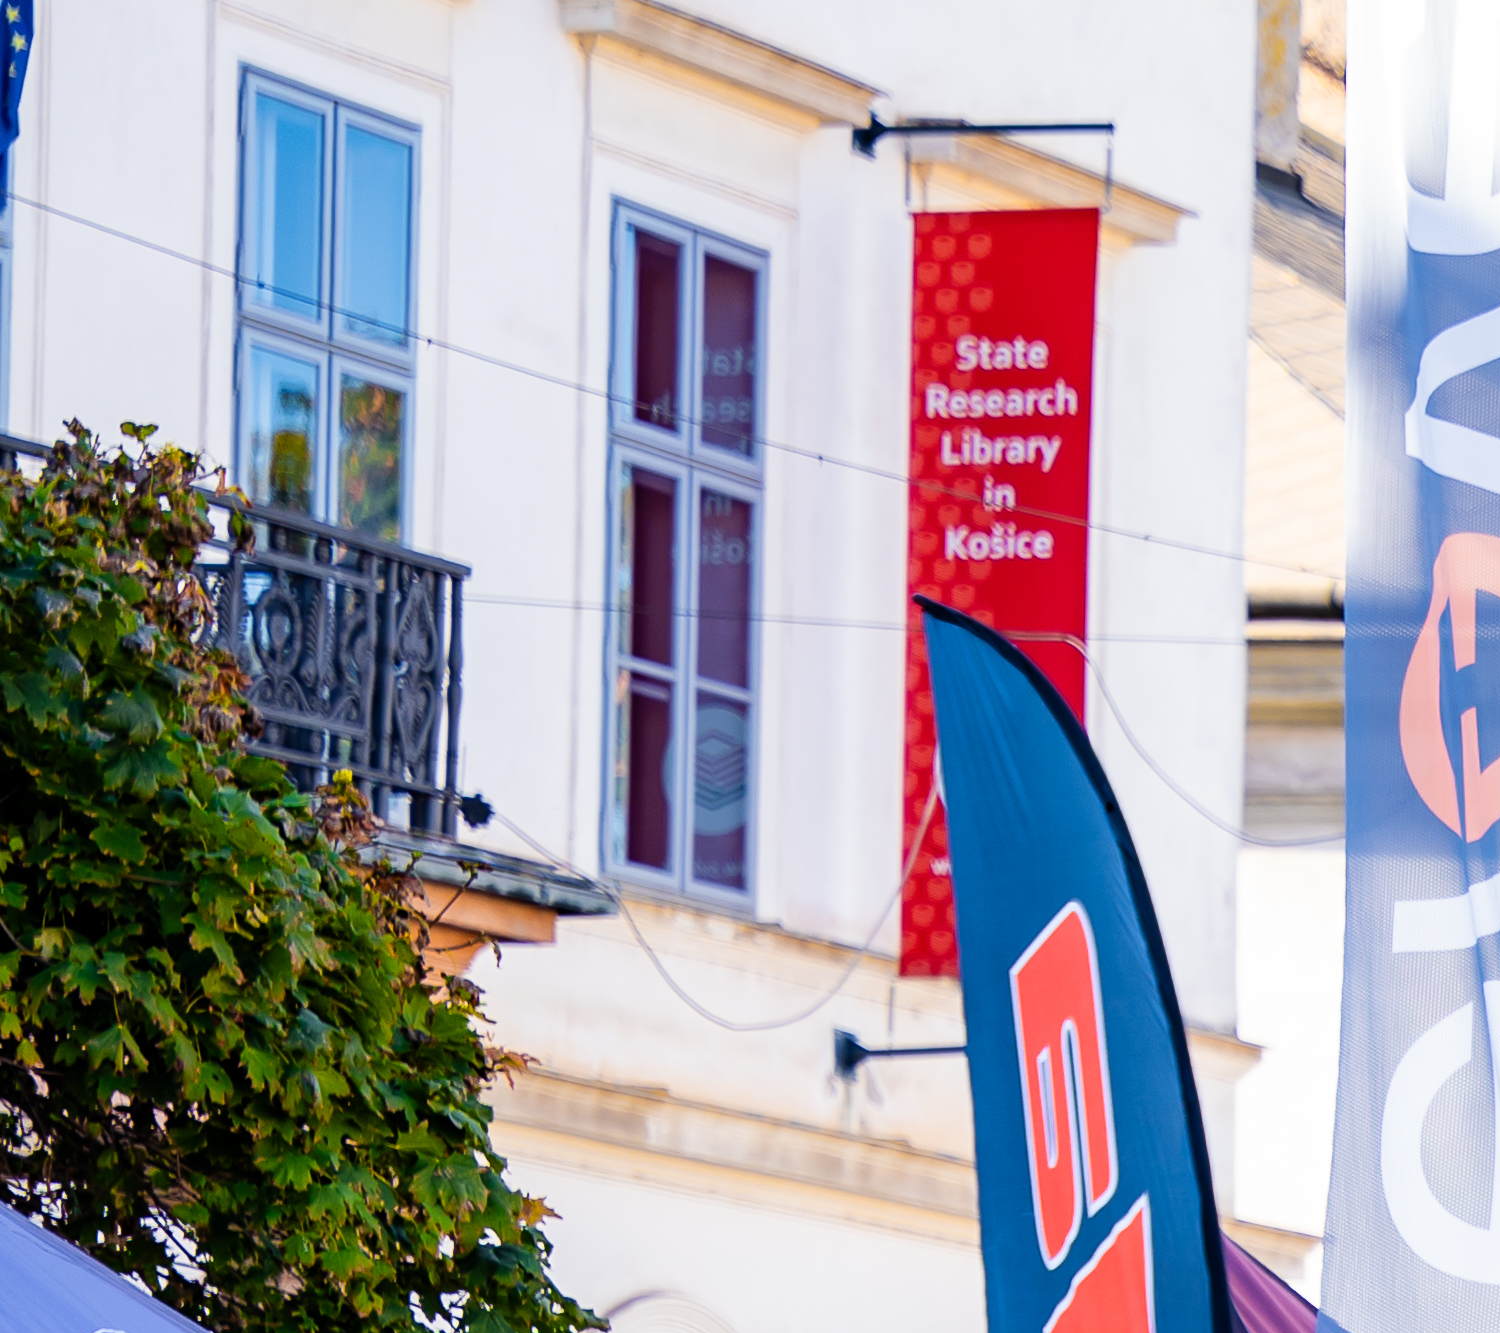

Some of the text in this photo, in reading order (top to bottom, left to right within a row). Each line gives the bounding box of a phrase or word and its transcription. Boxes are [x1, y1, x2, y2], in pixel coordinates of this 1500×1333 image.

[956, 337, 1048, 370] State
[925, 384, 1077, 417] Research
[941, 433, 1060, 474] Library
[984, 480, 1015, 509] in
[945, 525, 1053, 562] Košice
